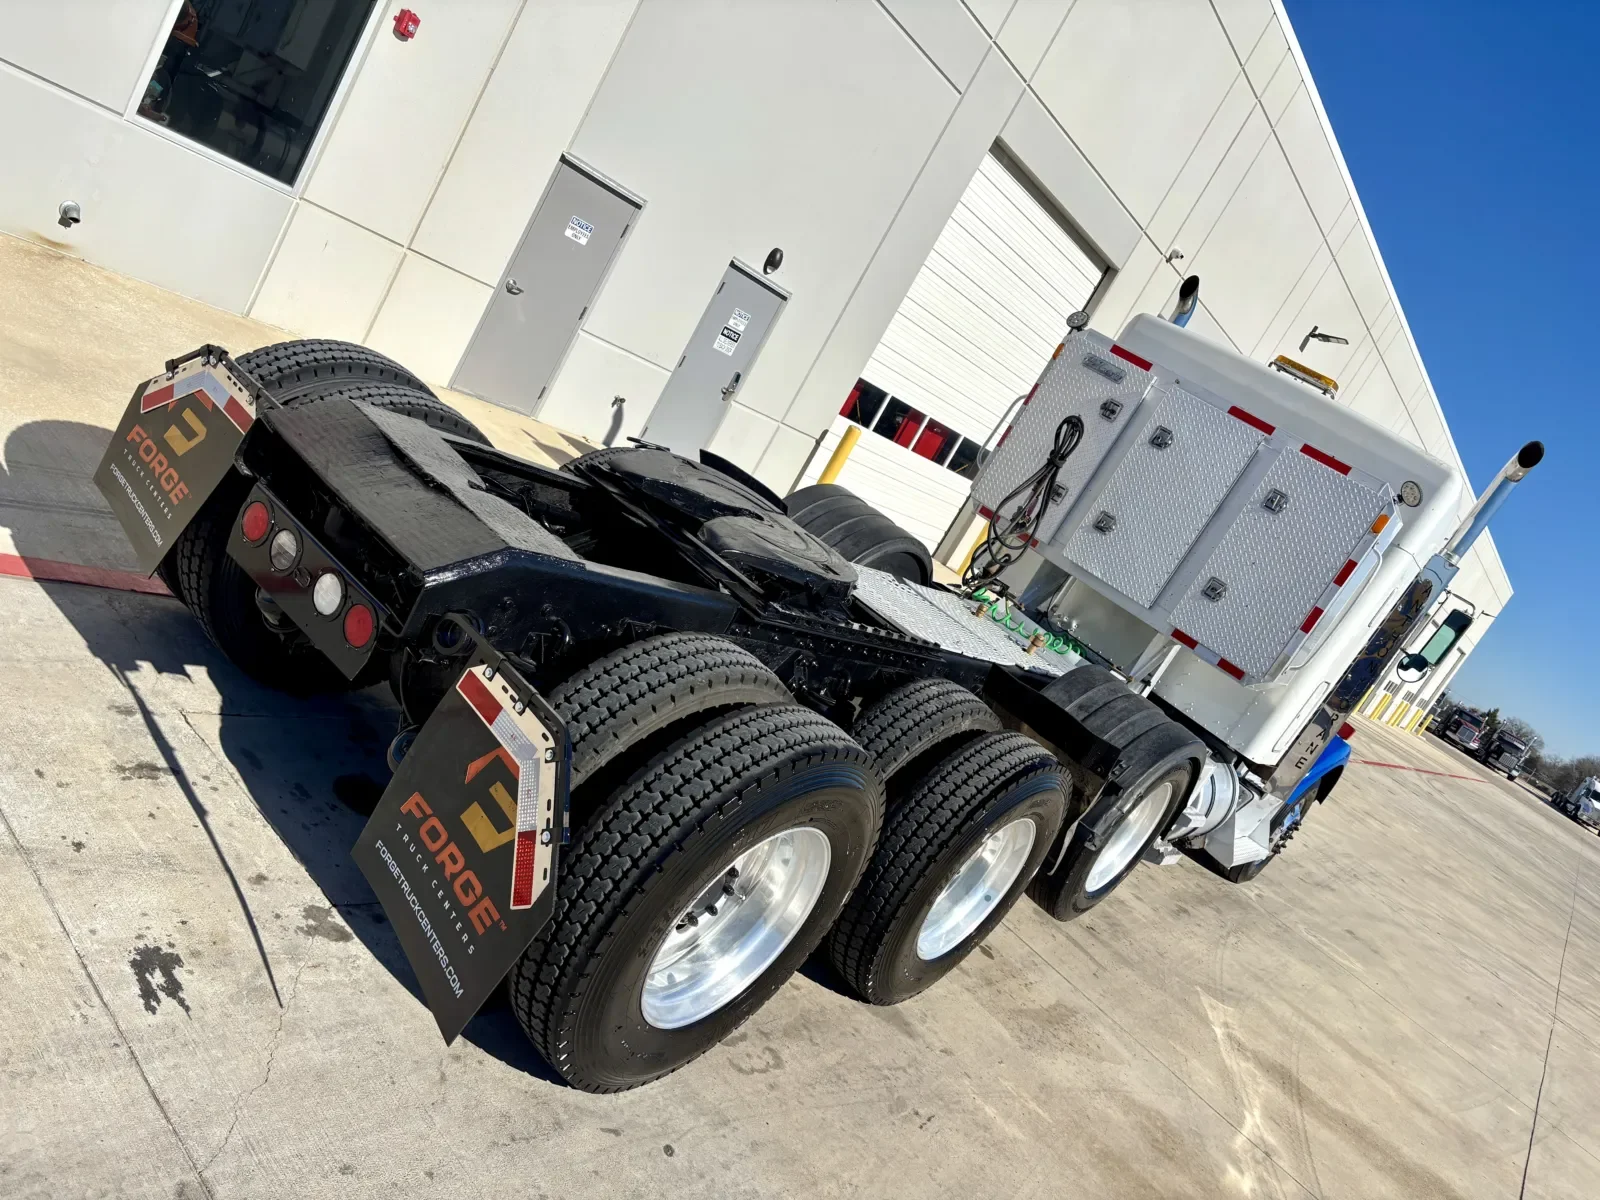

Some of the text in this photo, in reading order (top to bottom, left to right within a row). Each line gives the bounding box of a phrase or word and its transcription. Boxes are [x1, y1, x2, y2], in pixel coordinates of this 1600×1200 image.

[571, 217, 593, 233] NOTICE
[722, 328, 739, 341] NOTICE
[109, 463, 163, 548] FORGETRUCKCENTERS.COM
[123, 449, 172, 520] TRUCK CENTERS
[126, 424, 189, 505] FORGE
[396, 823, 475, 955] TRUCK CENTERS
[400, 791, 500, 936] FORGE
[375, 839, 464, 998] FORGETRUCKCENTERS.COM
